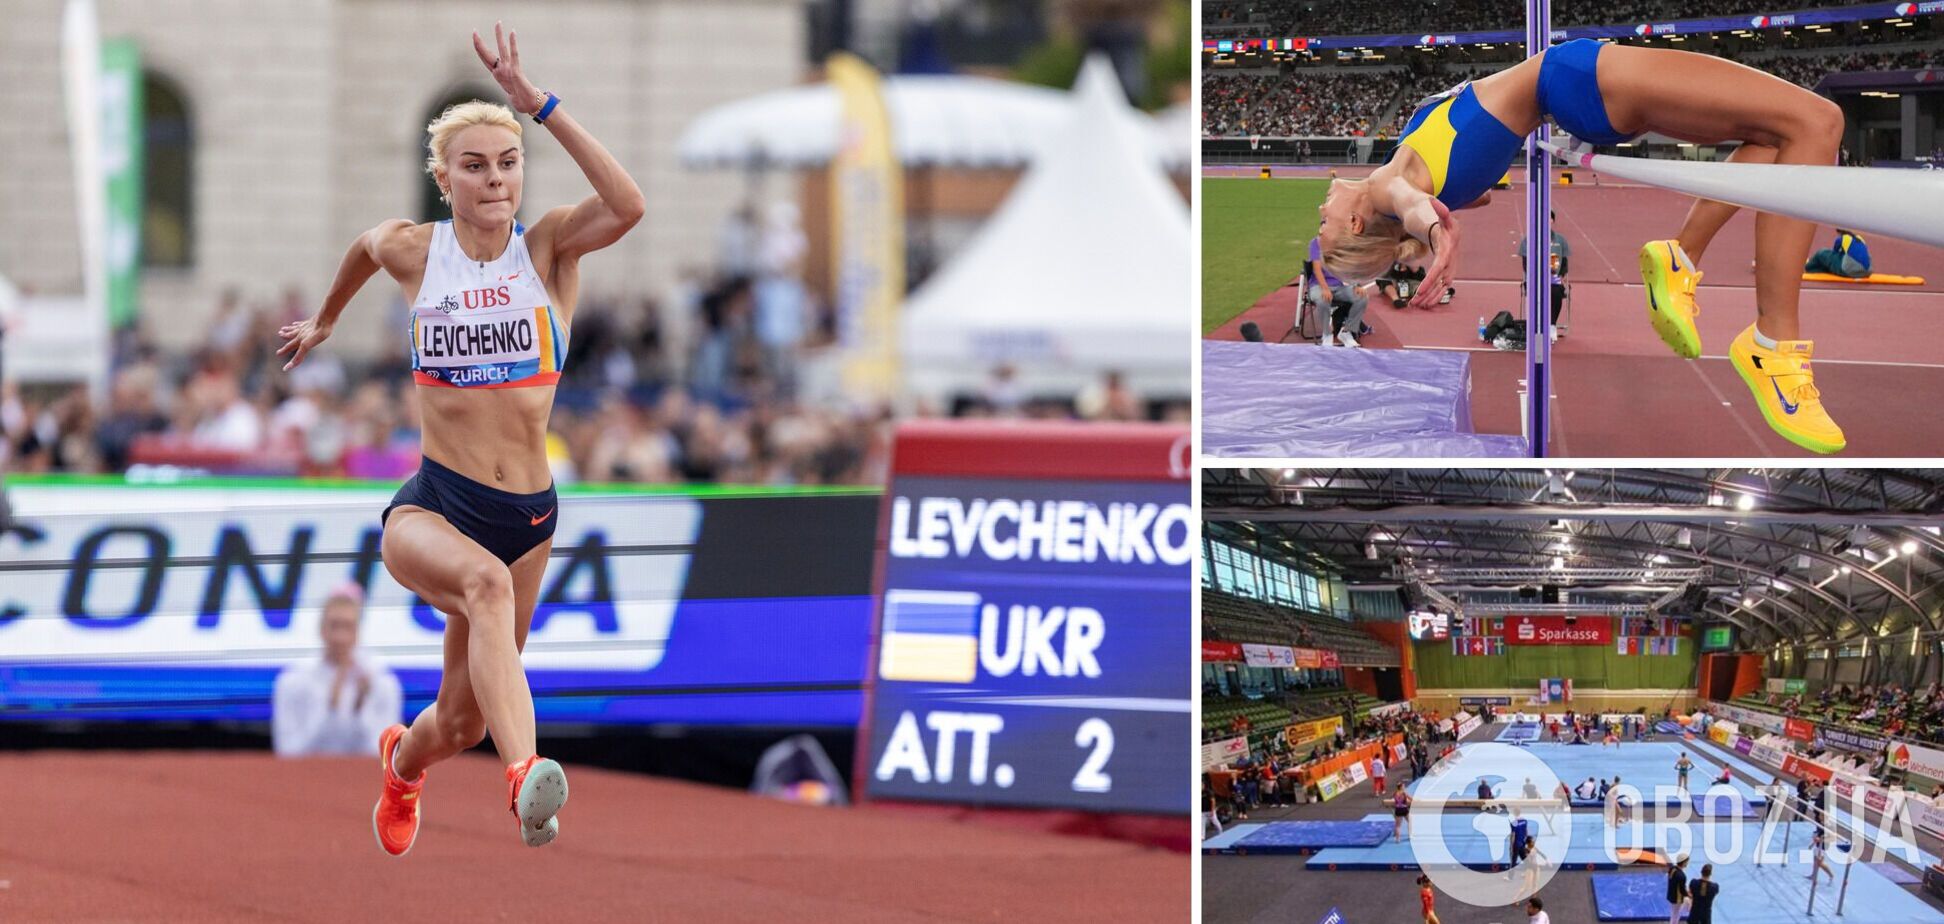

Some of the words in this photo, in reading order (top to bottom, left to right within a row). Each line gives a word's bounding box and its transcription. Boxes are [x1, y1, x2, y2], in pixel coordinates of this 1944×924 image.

[462, 286, 511, 310] UBS
[423, 319, 533, 358] LEVCHENKO
[450, 366, 509, 383] ZURICH
[890, 496, 1191, 566] LEVCHENKO
[979, 604, 1106, 678] UKR
[1539, 628, 1599, 641] Sparkasse
[875, 710, 1015, 788] ATT.
[1072, 717, 1114, 793] 2
